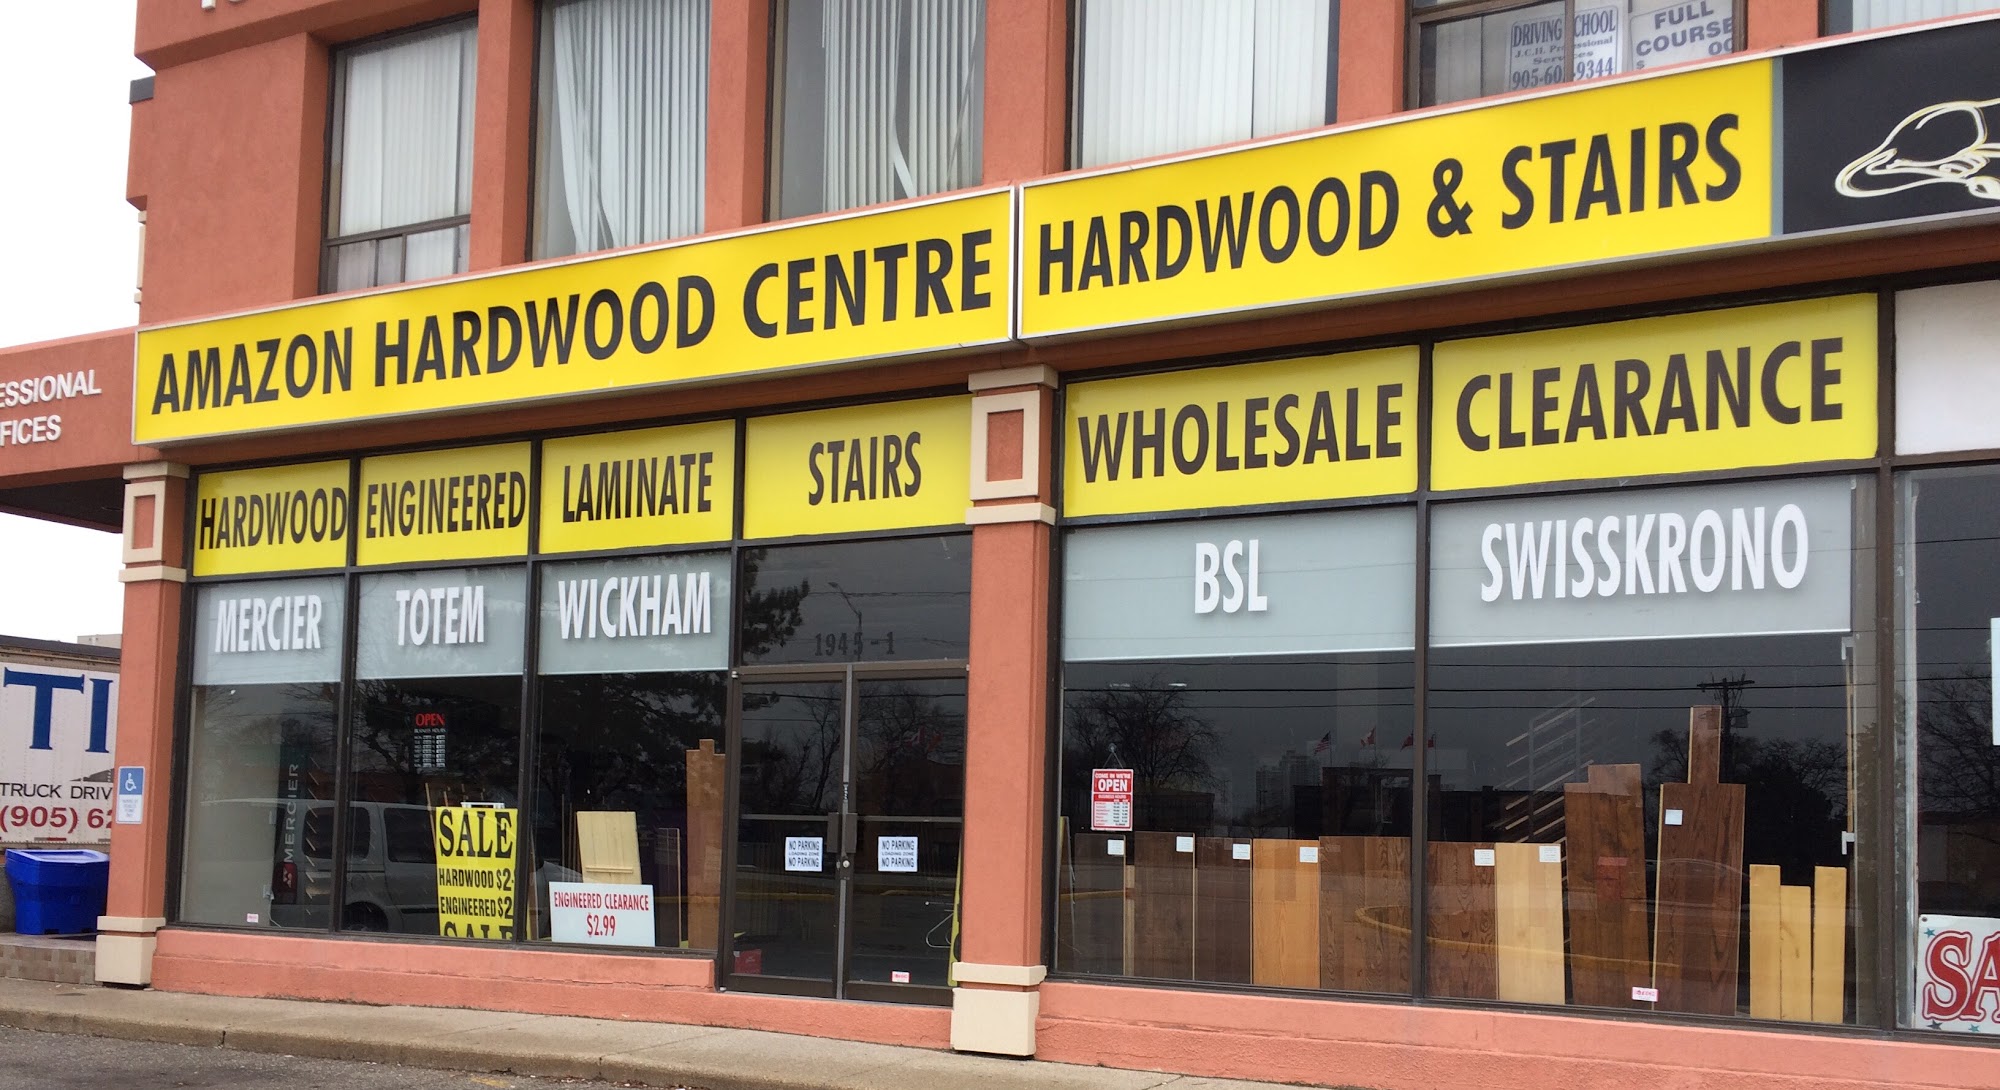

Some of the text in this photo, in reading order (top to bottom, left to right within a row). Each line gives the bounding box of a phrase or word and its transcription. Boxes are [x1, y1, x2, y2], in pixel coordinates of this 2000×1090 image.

[1512, 9, 1616, 48] DRIVING CHOOL
[1654, 0, 1714, 30] FULL
[1533, 50, 1594, 65] Servces
[1549, 36, 1613, 53] Prssional
[1512, 57, 1614, 90] 905-60-9344
[1039, 113, 1742, 297] HARDWOOD & STAIRS
[152, 228, 992, 415] AMAZON HARDWOOD CENTRE
[1456, 337, 1844, 452] CLEARANCE
[1077, 382, 1403, 484] WHOLESALE
[562, 451, 713, 523] LAMINATE
[808, 431, 922, 506] STAIRS
[199, 487, 348, 551] HARDWOOD
[366, 470, 526, 539] ENGINEERED
[1480, 503, 1809, 603] SWISSKRONO
[1193, 538, 1269, 615] BSL
[215, 594, 323, 653] MERCIER
[396, 584, 485, 647] TOTEM
[558, 572, 712, 640] WICKHAM
[415, 713, 446, 727] OPEN
[0, 783, 113, 800] TRUCK DRIV
[1098, 779, 1128, 791] OPEN
[0, 805, 78, 833] (905)
[284, 763, 298, 863] MERCIER
[439, 809, 513, 859] SALE
[788, 840, 820, 851] NO PARKING
[881, 840, 915, 851] NO PARKING
[439, 867, 494, 888] HARDWOOD
[788, 857, 820, 868] NO PARKING
[881, 857, 915, 868] NO PARKING
[440, 896, 496, 917] ENGINEERED
[554, 891, 649, 911] ENGINEERED CLEARANCE
[586, 912, 616, 937] $2.99
[1922, 930, 2000, 1023] SA
